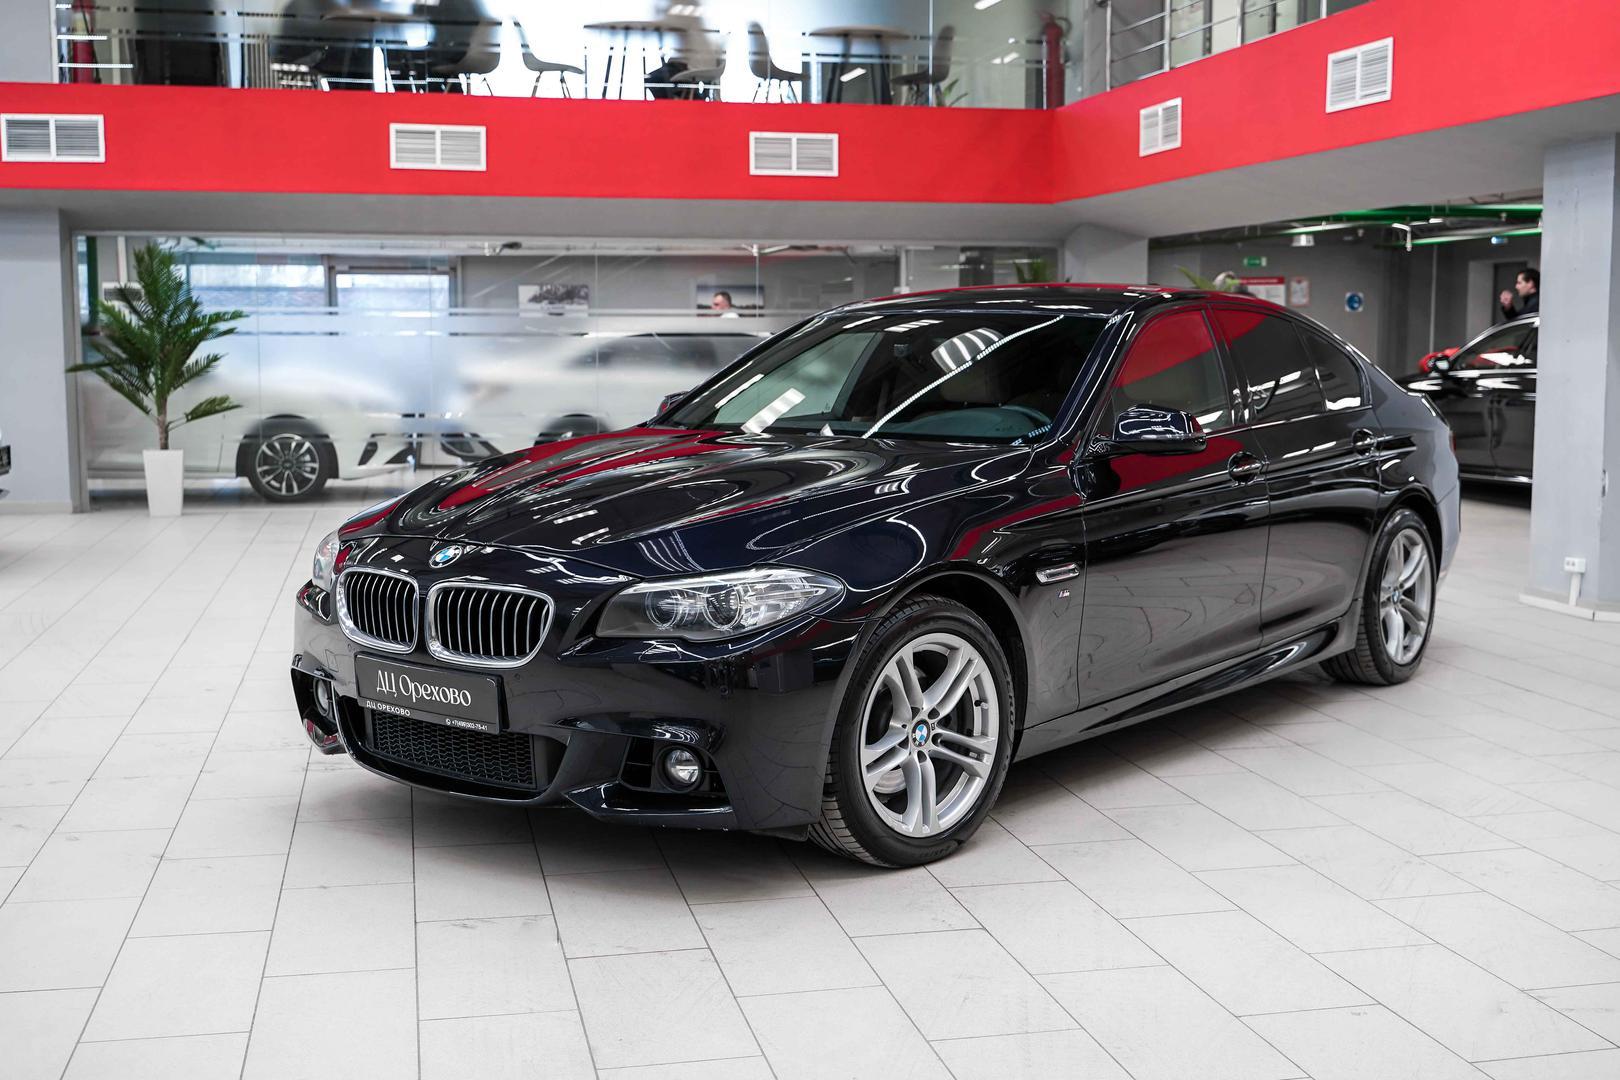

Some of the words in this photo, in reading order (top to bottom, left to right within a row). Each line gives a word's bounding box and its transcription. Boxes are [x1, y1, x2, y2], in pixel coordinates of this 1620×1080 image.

[376, 670, 397, 698] ДЦ
[399, 674, 472, 707] Орехово
[366, 700, 376, 709] ДЦ
[377, 703, 410, 717] ОРЕХОВО
